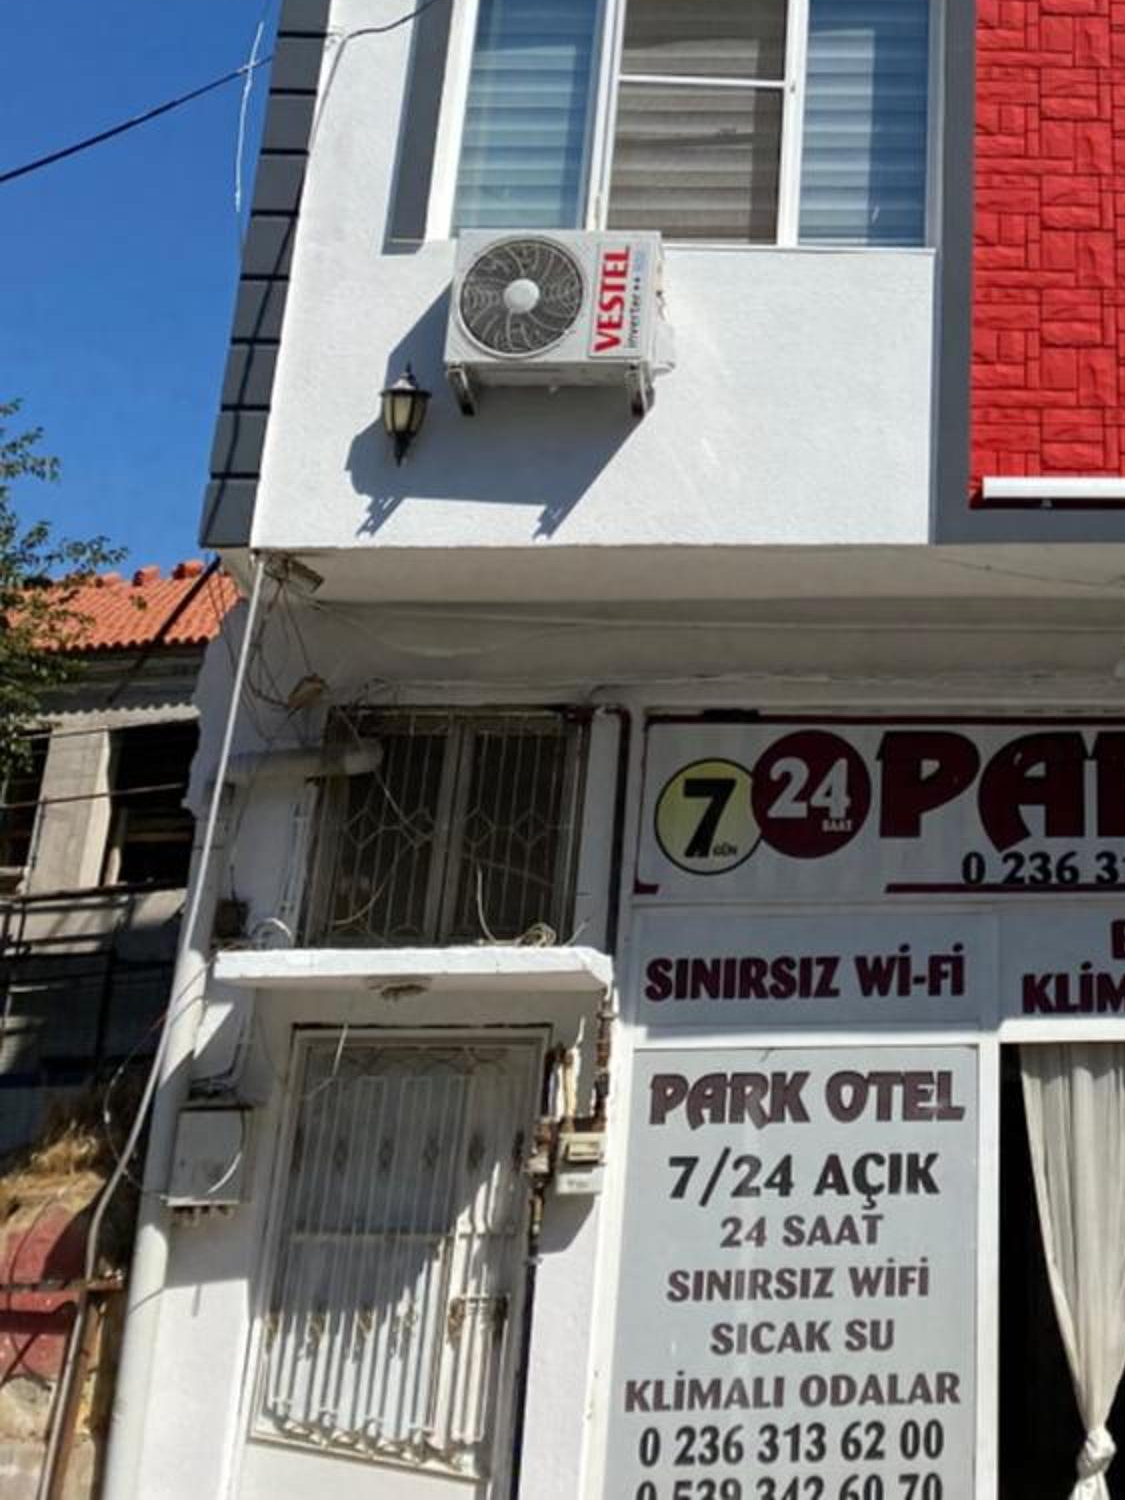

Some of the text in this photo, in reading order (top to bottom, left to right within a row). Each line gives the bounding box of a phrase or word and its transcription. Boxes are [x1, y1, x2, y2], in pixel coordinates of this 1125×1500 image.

[594, 246, 631, 352] VESTEL
[767, 756, 852, 819] 24
[683, 778, 737, 858] 7
[962, 851, 986, 884] 0
[1002, 851, 1079, 884] 236
[645, 956, 840, 1002] SINIRSIZ
[649, 1070, 966, 1130] PARK OTEL
[668, 1147, 940, 1210] 7/24 AÇIK
[720, 1214, 883, 1248] 24 SAAT
[666, 1257, 929, 1303] SINIRSIZ WİFİ
[710, 1319, 895, 1355] SICAK SU
[624, 1369, 961, 1412] KLİMALI ODALAR
[638, 1418, 945, 1468] 0 236 313 62 00
